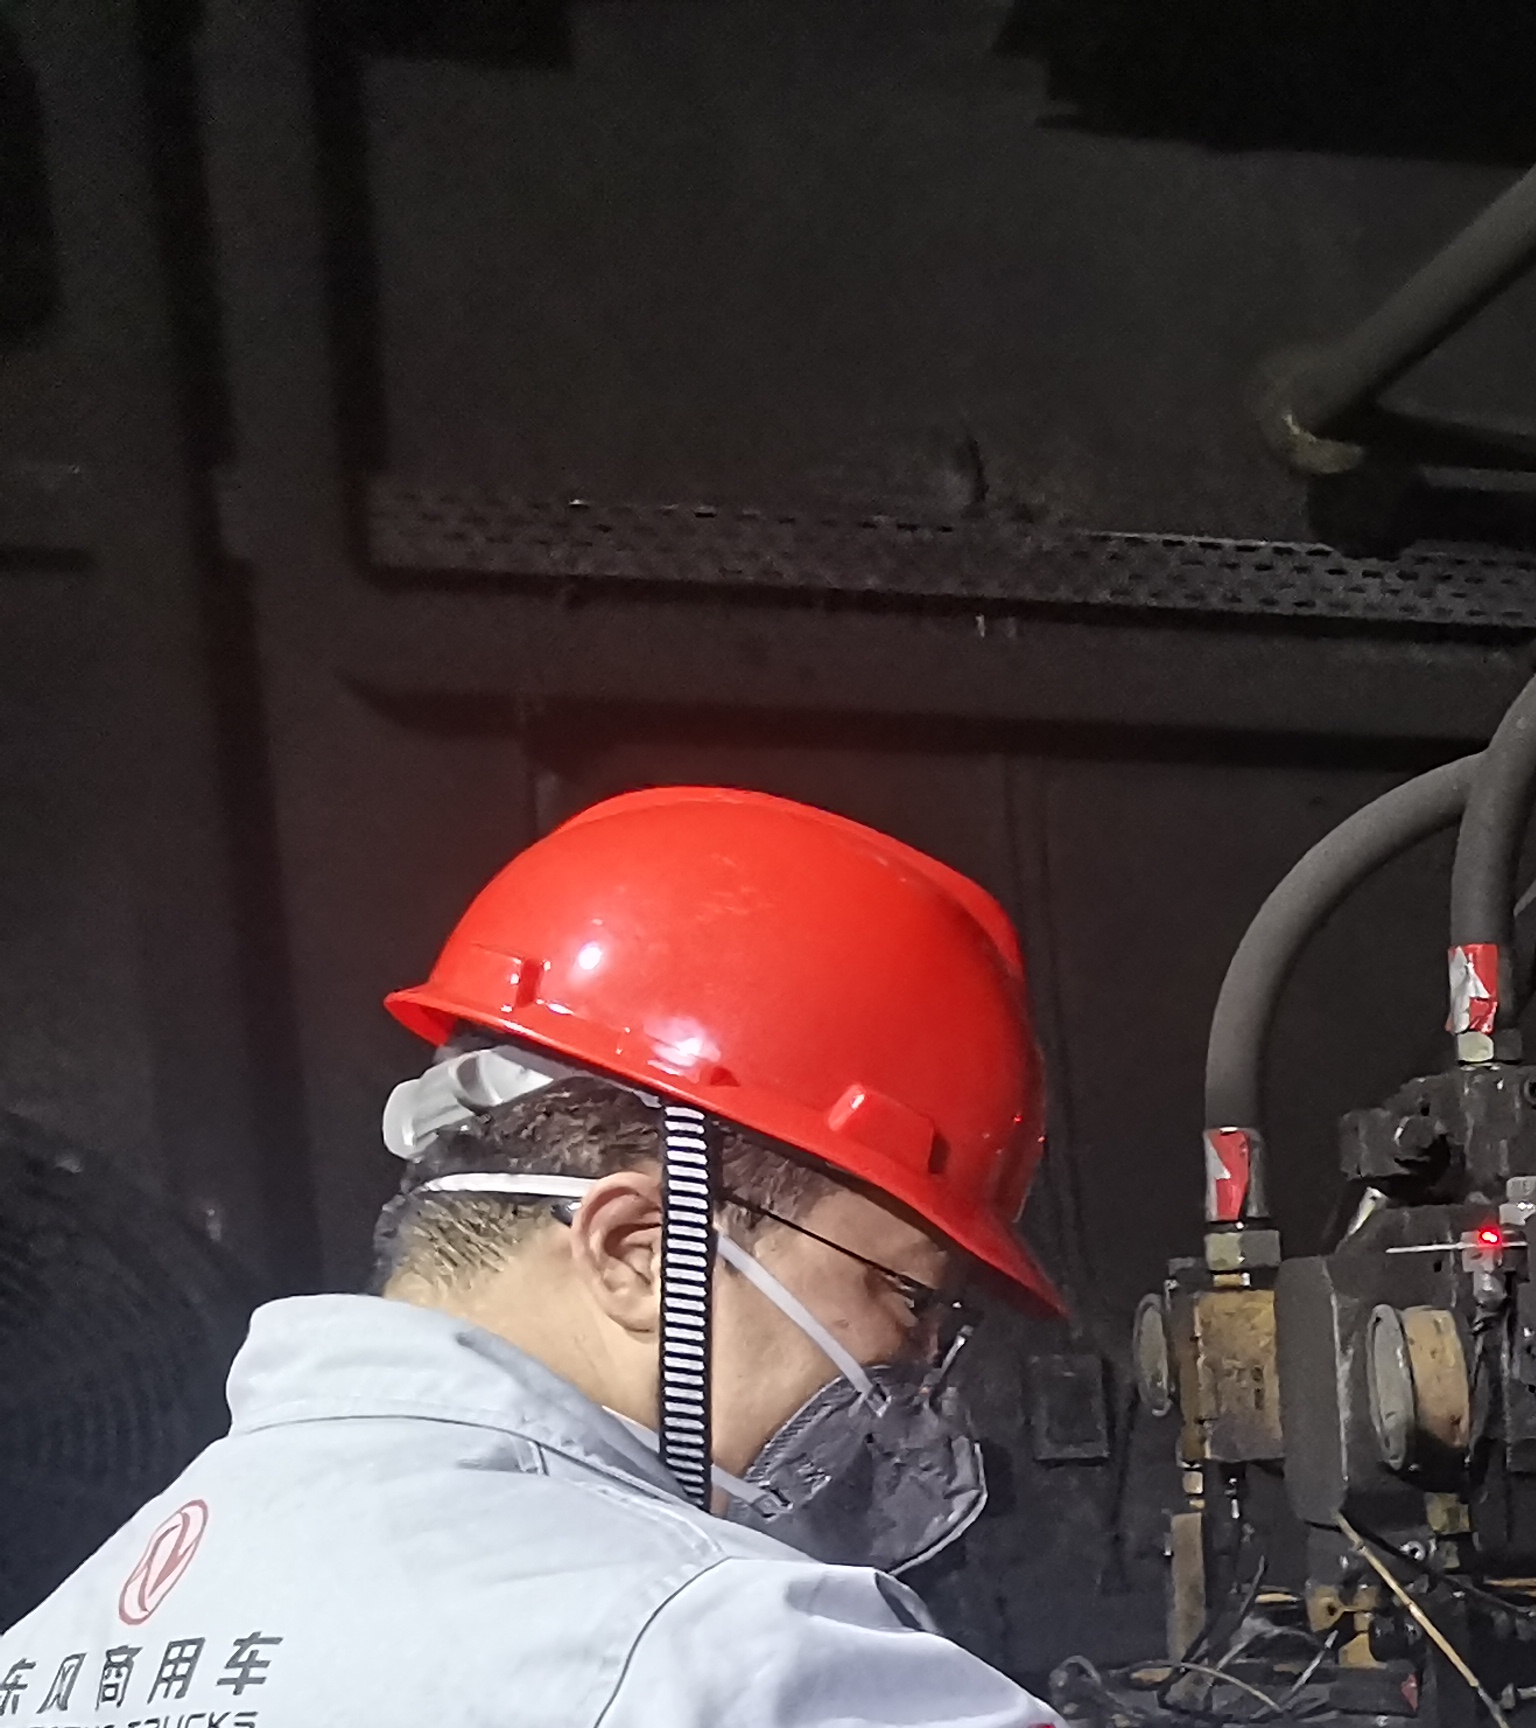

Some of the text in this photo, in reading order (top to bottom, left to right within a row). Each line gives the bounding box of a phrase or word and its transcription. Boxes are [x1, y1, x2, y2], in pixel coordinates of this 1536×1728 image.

[0, 1631, 283, 1716] 东风商用车
